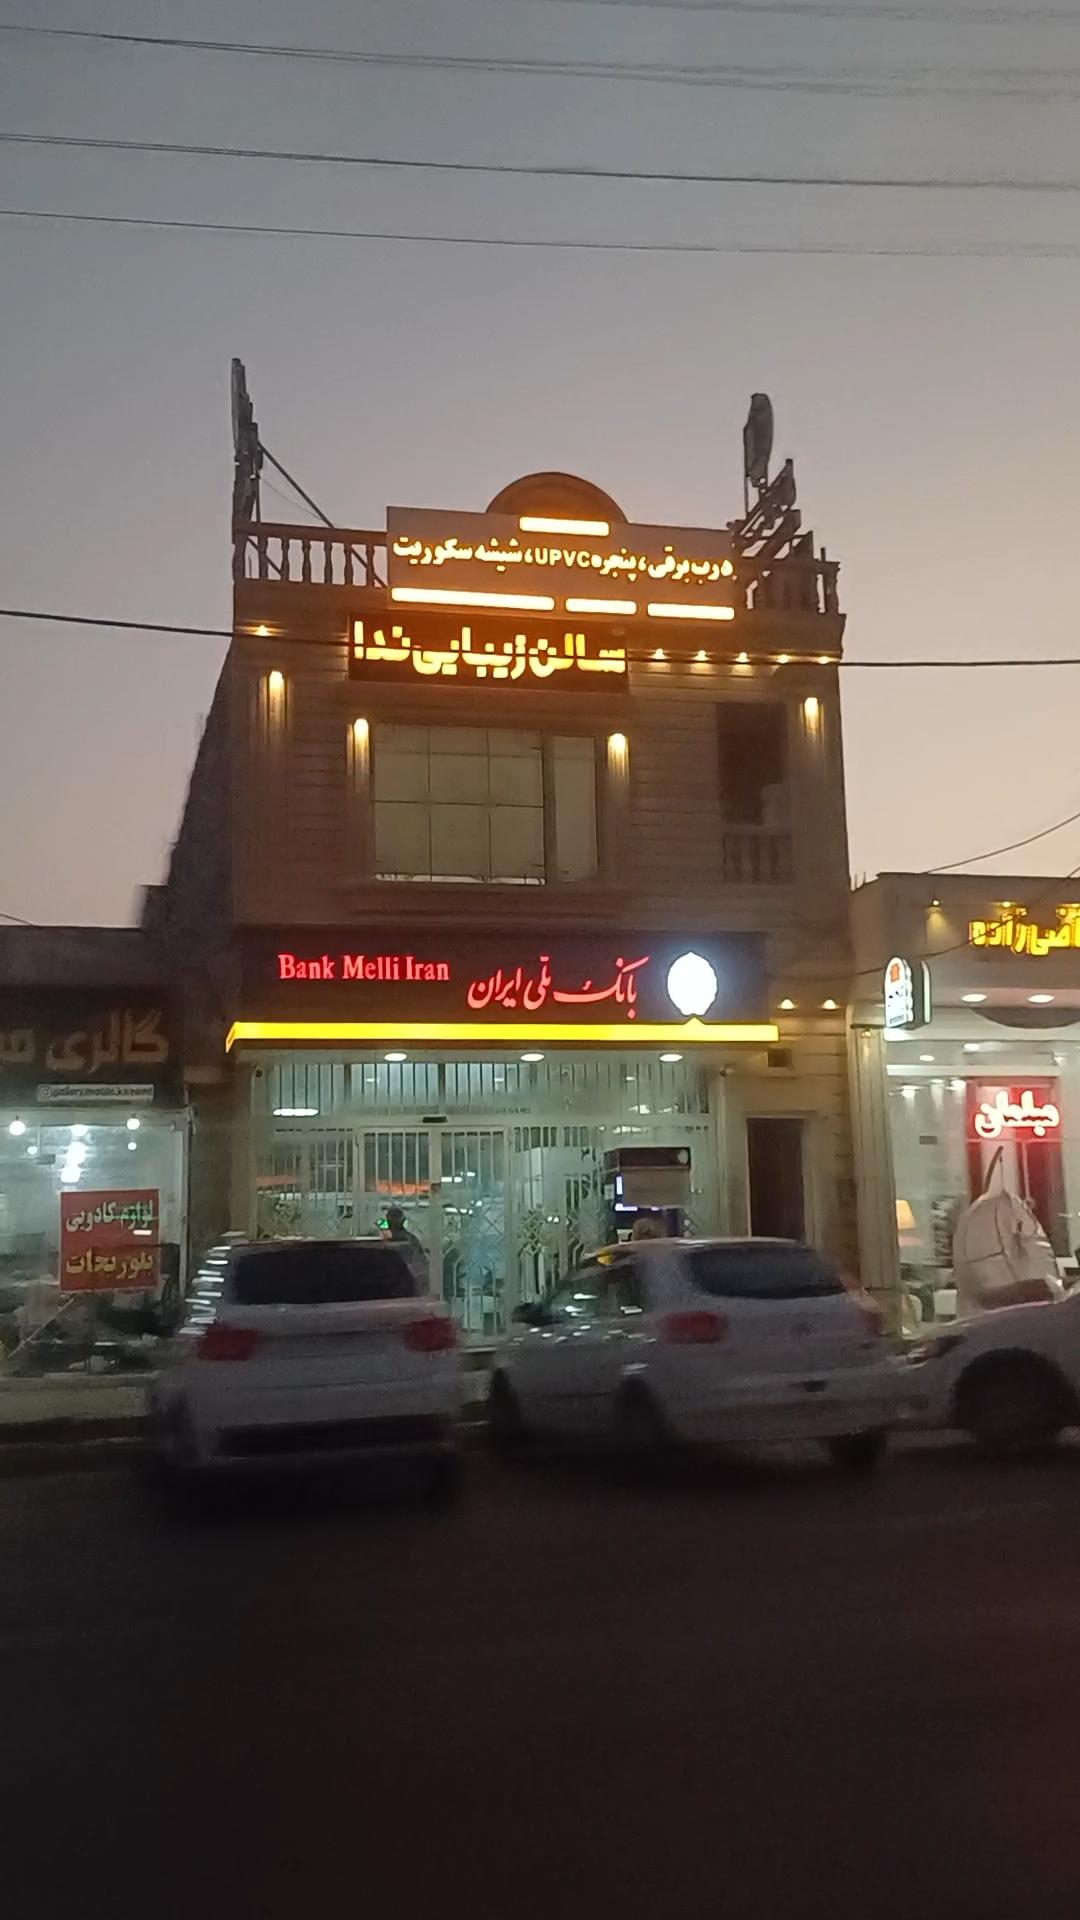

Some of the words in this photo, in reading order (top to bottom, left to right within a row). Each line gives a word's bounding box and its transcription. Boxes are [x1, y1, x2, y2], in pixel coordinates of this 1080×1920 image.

[393, 536, 473, 565] سکوریت
[474, 538, 522, 572] شیشه
[412, 626, 526, 680] زیبایی
[528, 633, 626, 678] سالن
[278, 954, 335, 980] Bank
[342, 955, 399, 980] Melli
[406, 956, 449, 981] Iran
[467, 967, 522, 1009] ایران
[553, 956, 649, 1019] بانک
[975, 1090, 1060, 1139] مبلمان
